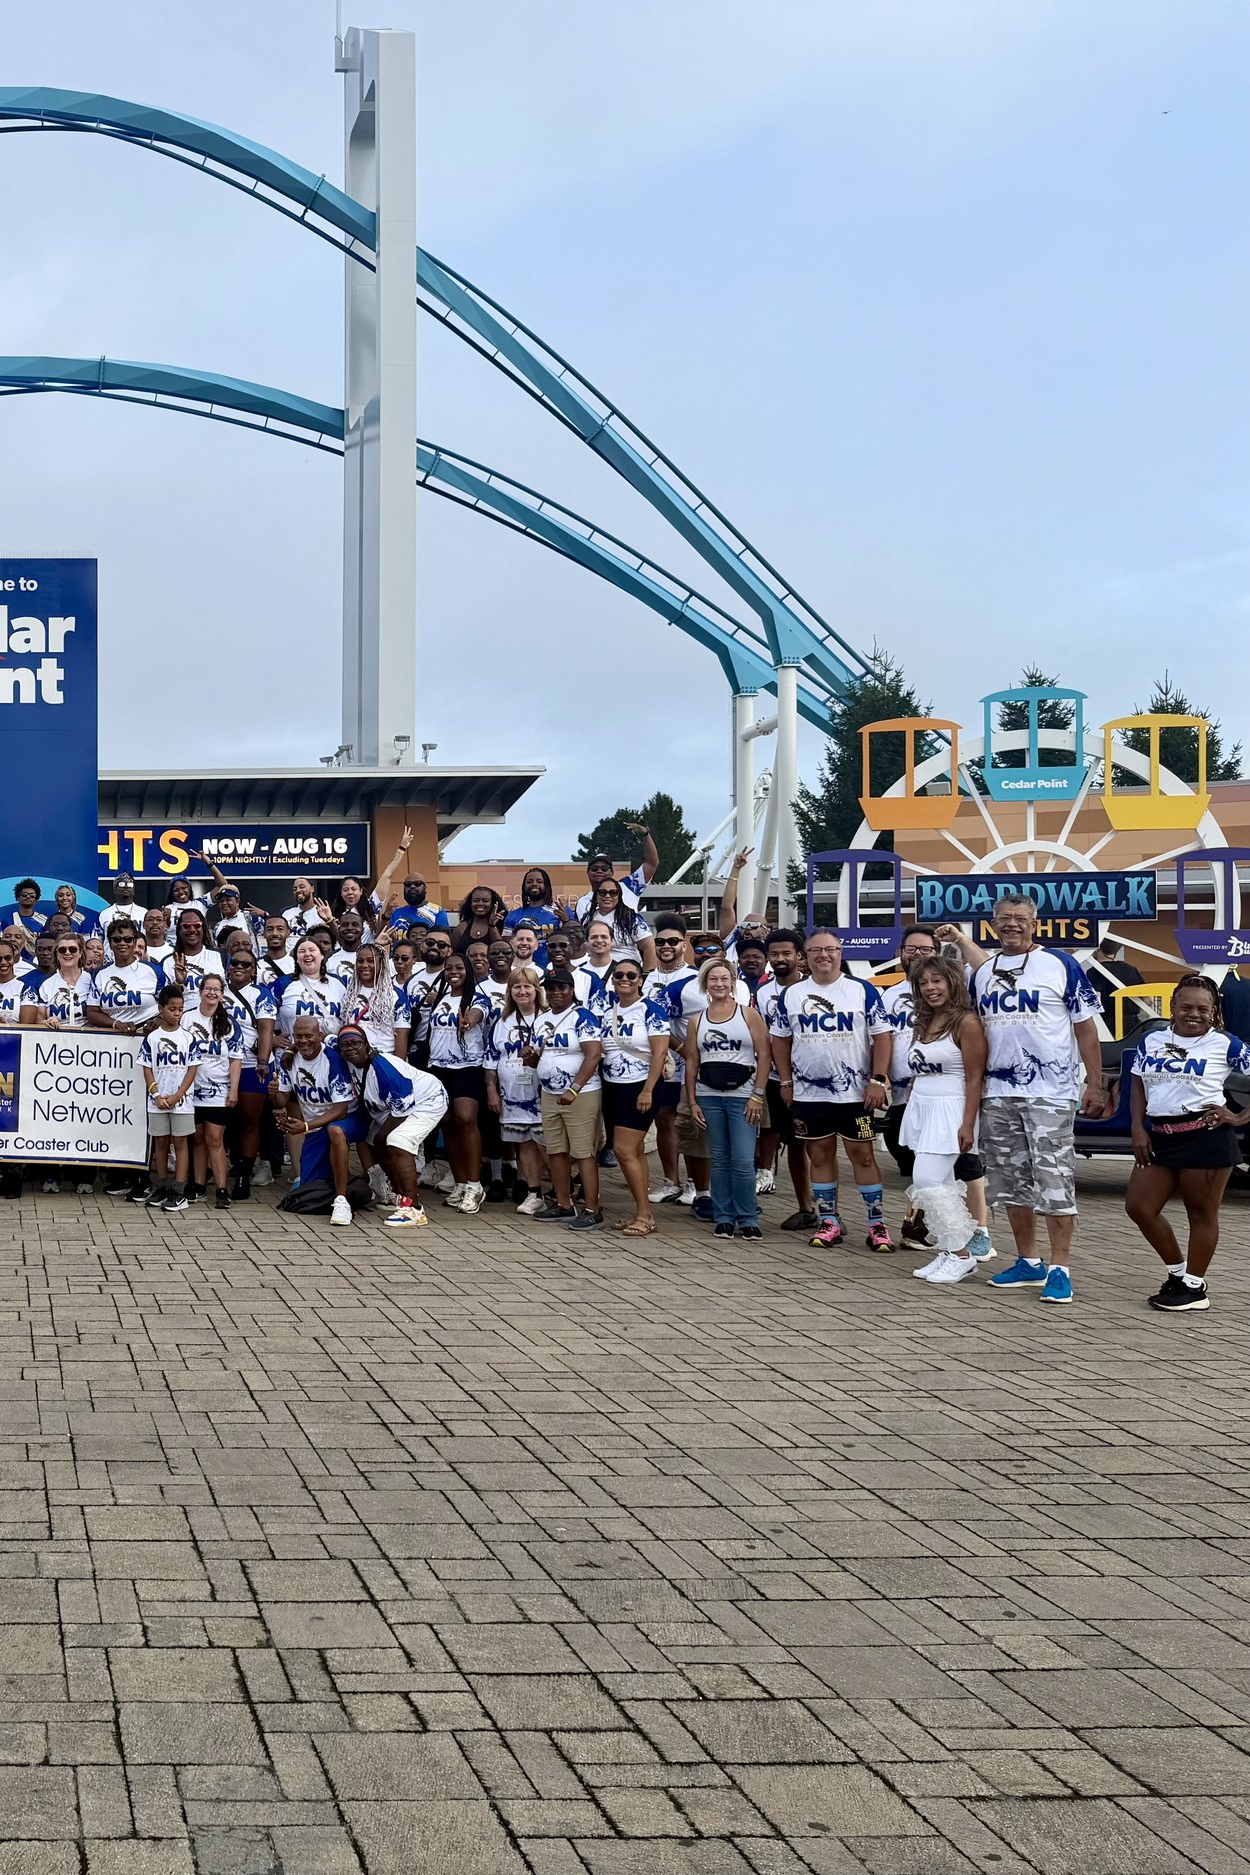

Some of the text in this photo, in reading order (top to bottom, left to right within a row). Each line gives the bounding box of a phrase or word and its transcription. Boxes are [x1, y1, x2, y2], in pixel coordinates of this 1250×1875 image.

[17, 577, 38, 591] to
[1001, 778, 1068, 789] Cedar Point
[97, 829, 191, 874] HTS
[203, 839, 256, 854] NOW
[273, 838, 318, 854] AUG
[323, 838, 348, 854] 16
[212, 856, 234, 864] -10PM
[235, 856, 268, 864] NIGHTLY
[272, 856, 309, 865] Excluding
[311, 856, 345, 865] Tuesdays
[979, 918, 1090, 941] NHTS
[100, 990, 142, 1008] MCN
[980, 989, 1040, 1015] MCN
[797, 1011, 854, 1033] MCN
[1005, 1013, 1039, 1021] Coaster
[826, 1032, 854, 1040] Coaster
[702, 1039, 742, 1053] MCN
[35, 1043, 134, 1069] Melanin
[156, 1052, 187, 1067] MCN
[909, 1061, 943, 1074] MCN
[1141, 1056, 1208, 1077] MCN
[34, 1071, 134, 1097] Coaster
[1170, 1073, 1202, 1082] Coaster
[295, 1084, 333, 1104] MCN
[33, 1099, 134, 1126] Network
[855, 1115, 871, 1125] HE'S
[860, 1124, 871, 1132] ON
[13, 1137, 71, 1152] Coaster
[75, 1139, 109, 1153] Club
